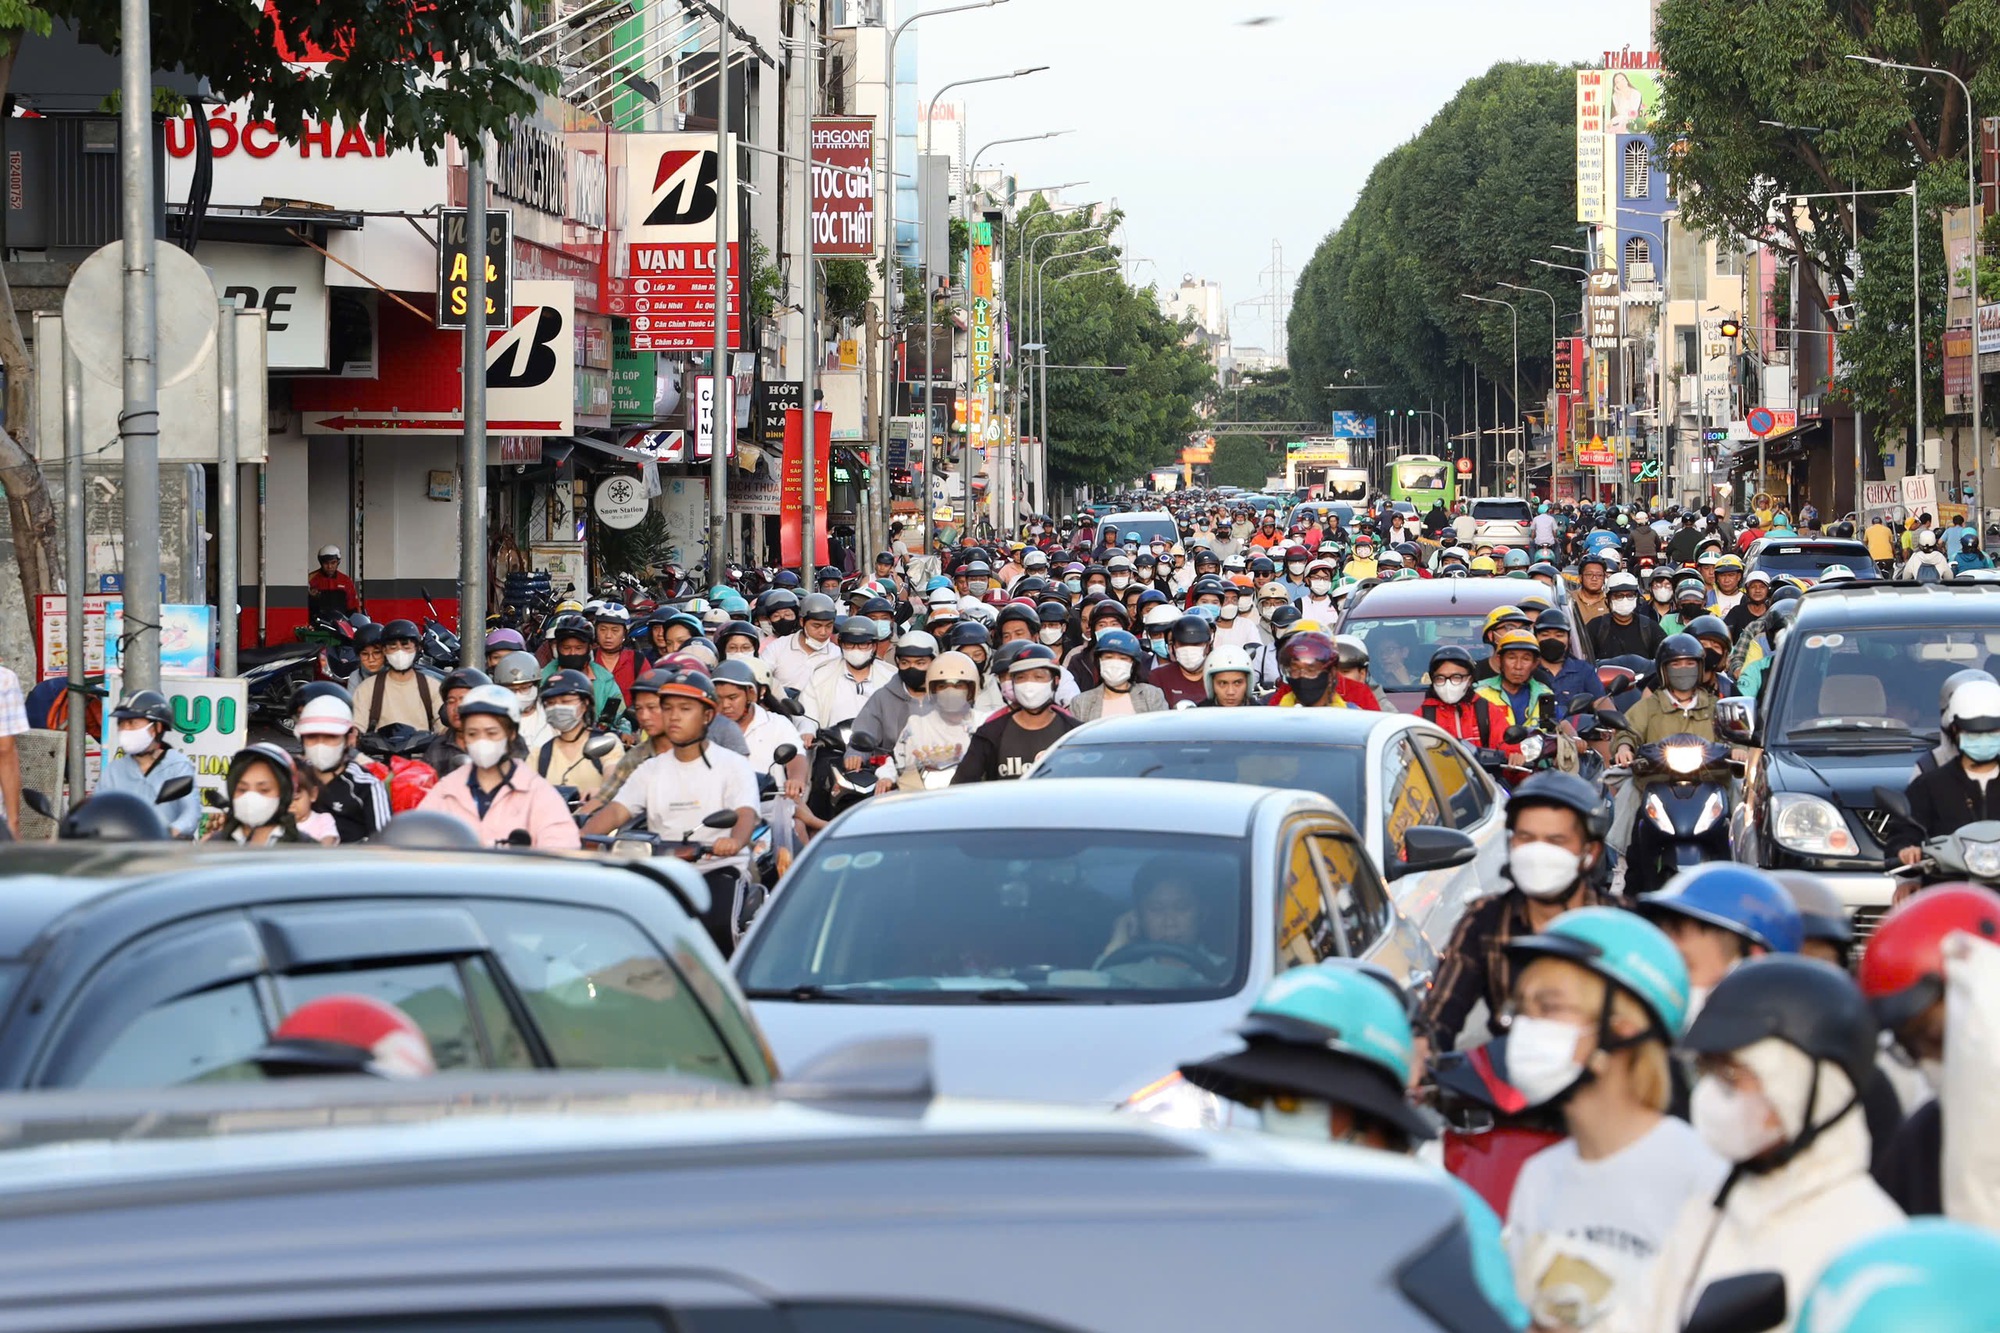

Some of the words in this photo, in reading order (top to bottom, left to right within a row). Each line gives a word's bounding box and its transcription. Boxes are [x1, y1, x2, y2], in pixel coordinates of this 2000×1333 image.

[812, 129, 869, 143] HAGONA
[10, 151, 21, 209] 162400752
[811, 203, 838, 246] TÓC
[840, 203, 873, 250] THẬT
[637, 250, 685, 273] VẠN
[768, 383, 799, 395] HỚT
[620, 506, 643, 514] Station
